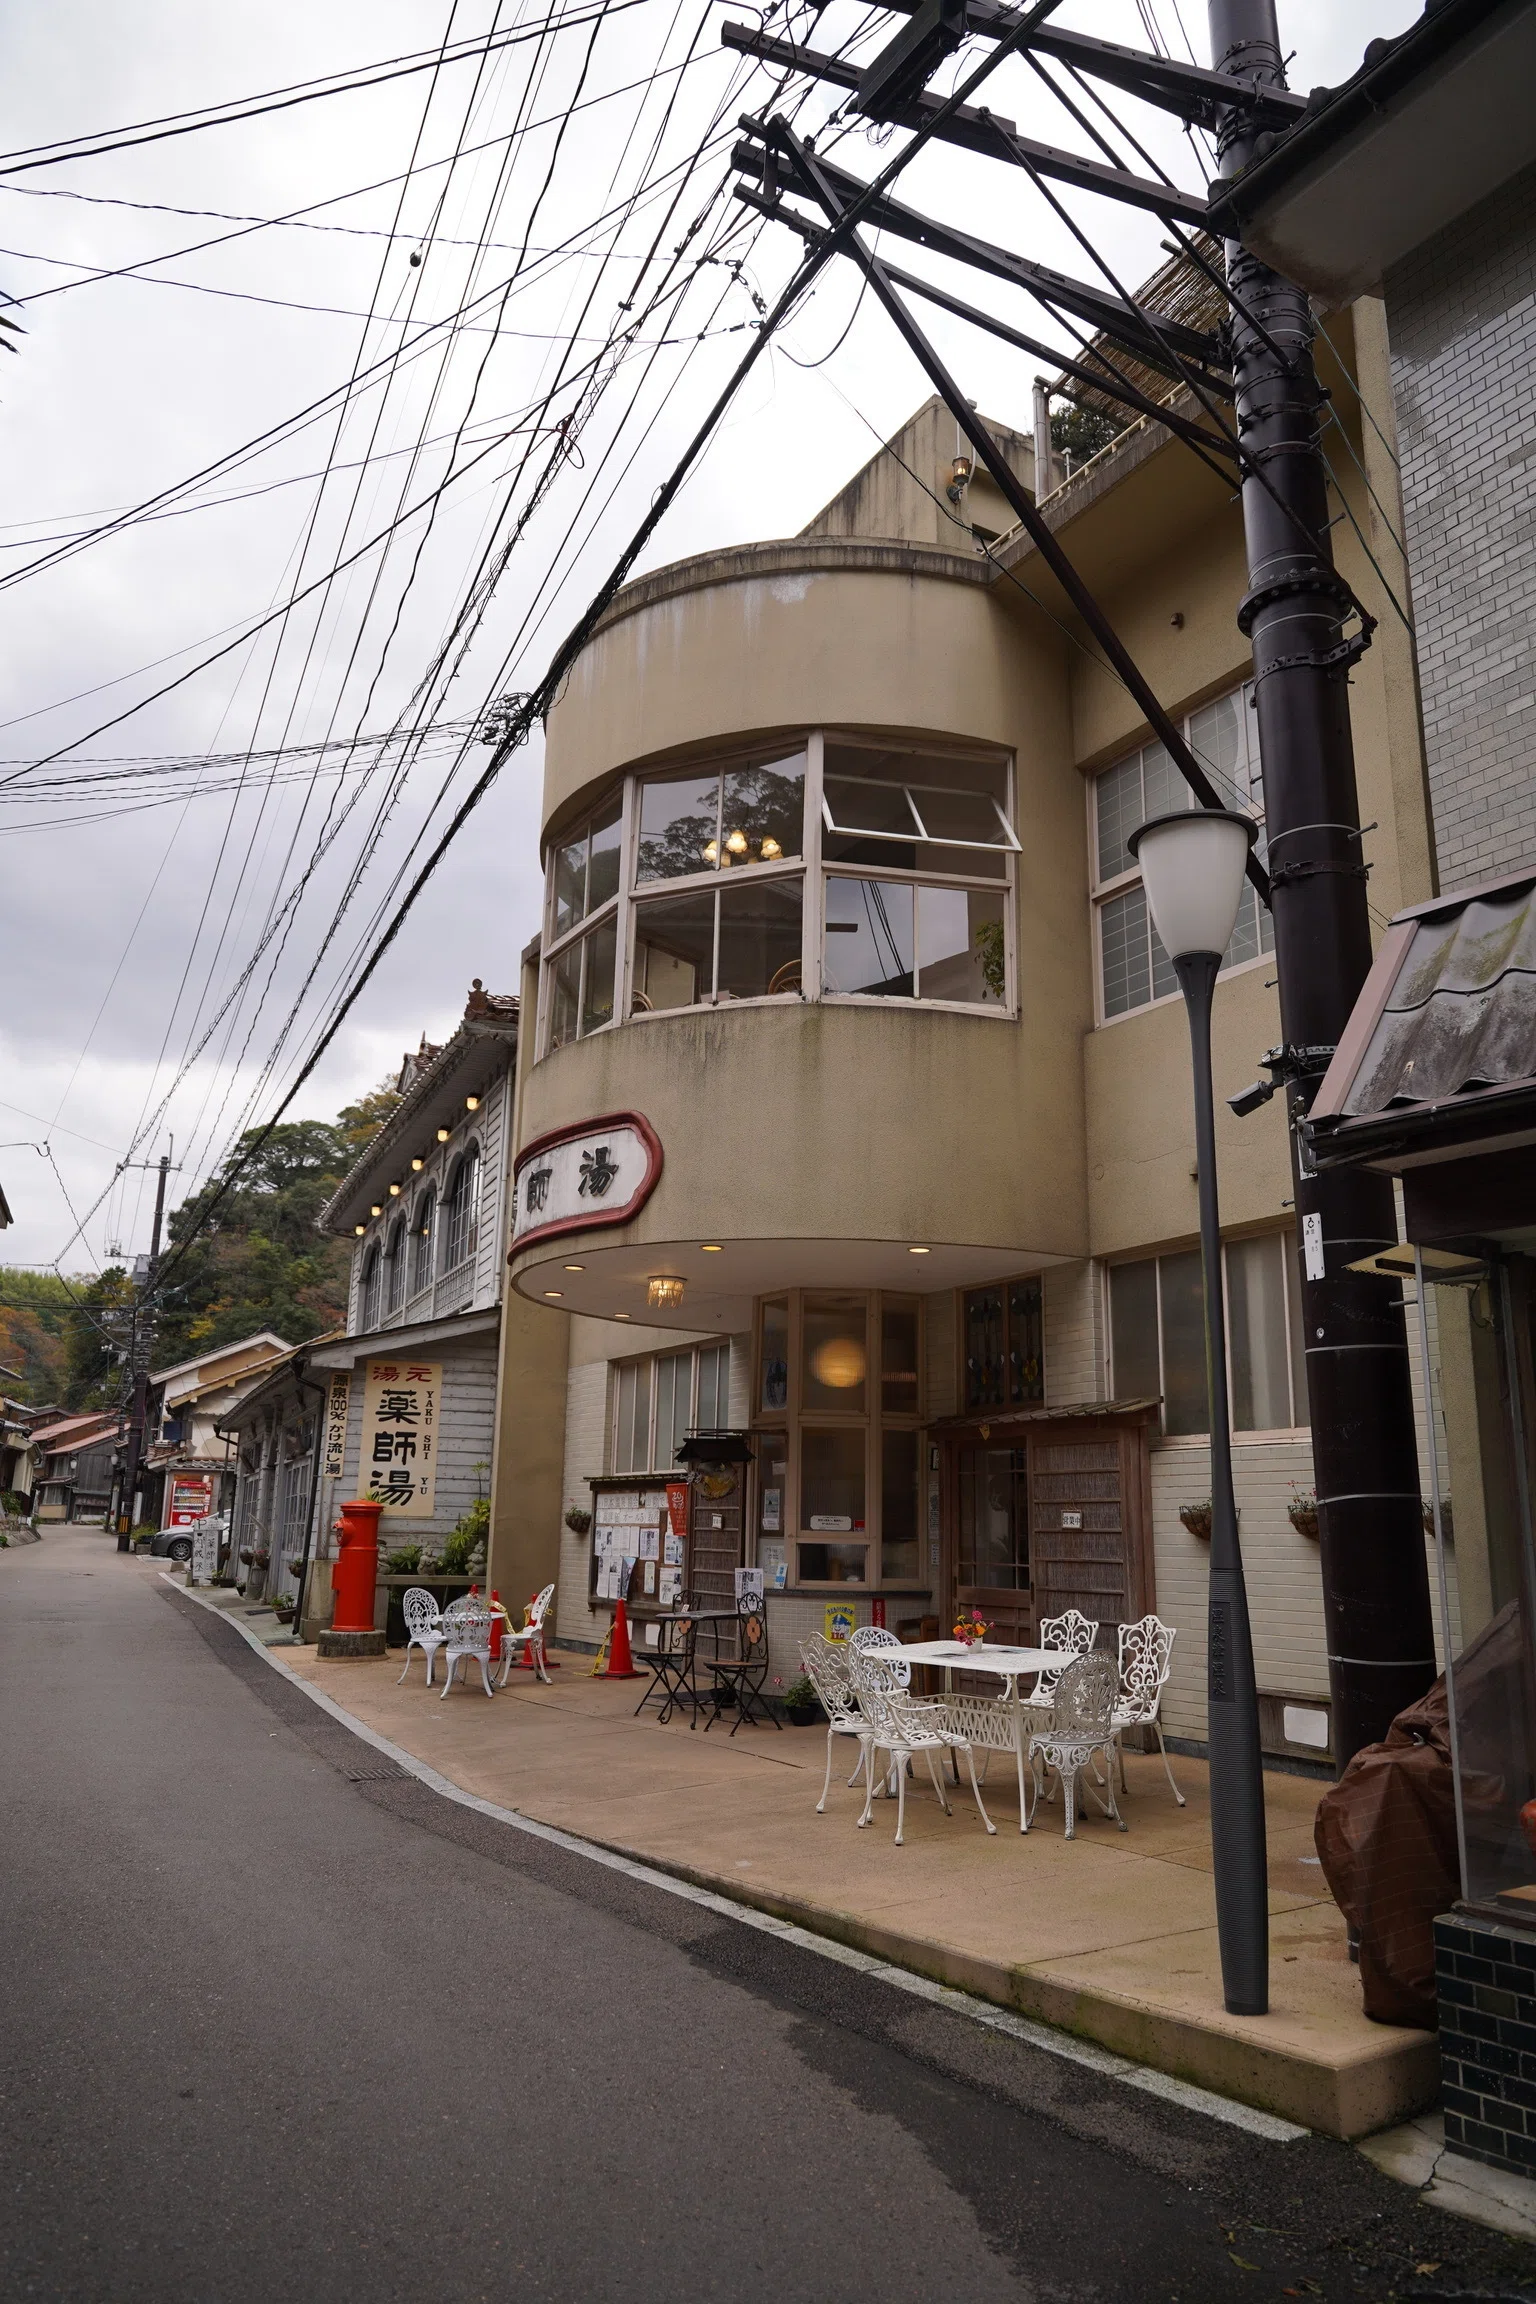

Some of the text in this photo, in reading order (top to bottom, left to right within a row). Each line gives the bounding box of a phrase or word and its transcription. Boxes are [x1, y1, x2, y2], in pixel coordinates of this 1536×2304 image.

[372, 1366, 433, 1383] 湯元
[369, 1388, 422, 1507] 薬師湯
[420, 1390, 435, 1495] YAKU SHI YU
[1063, 1515, 1081, 1526] 営業中
